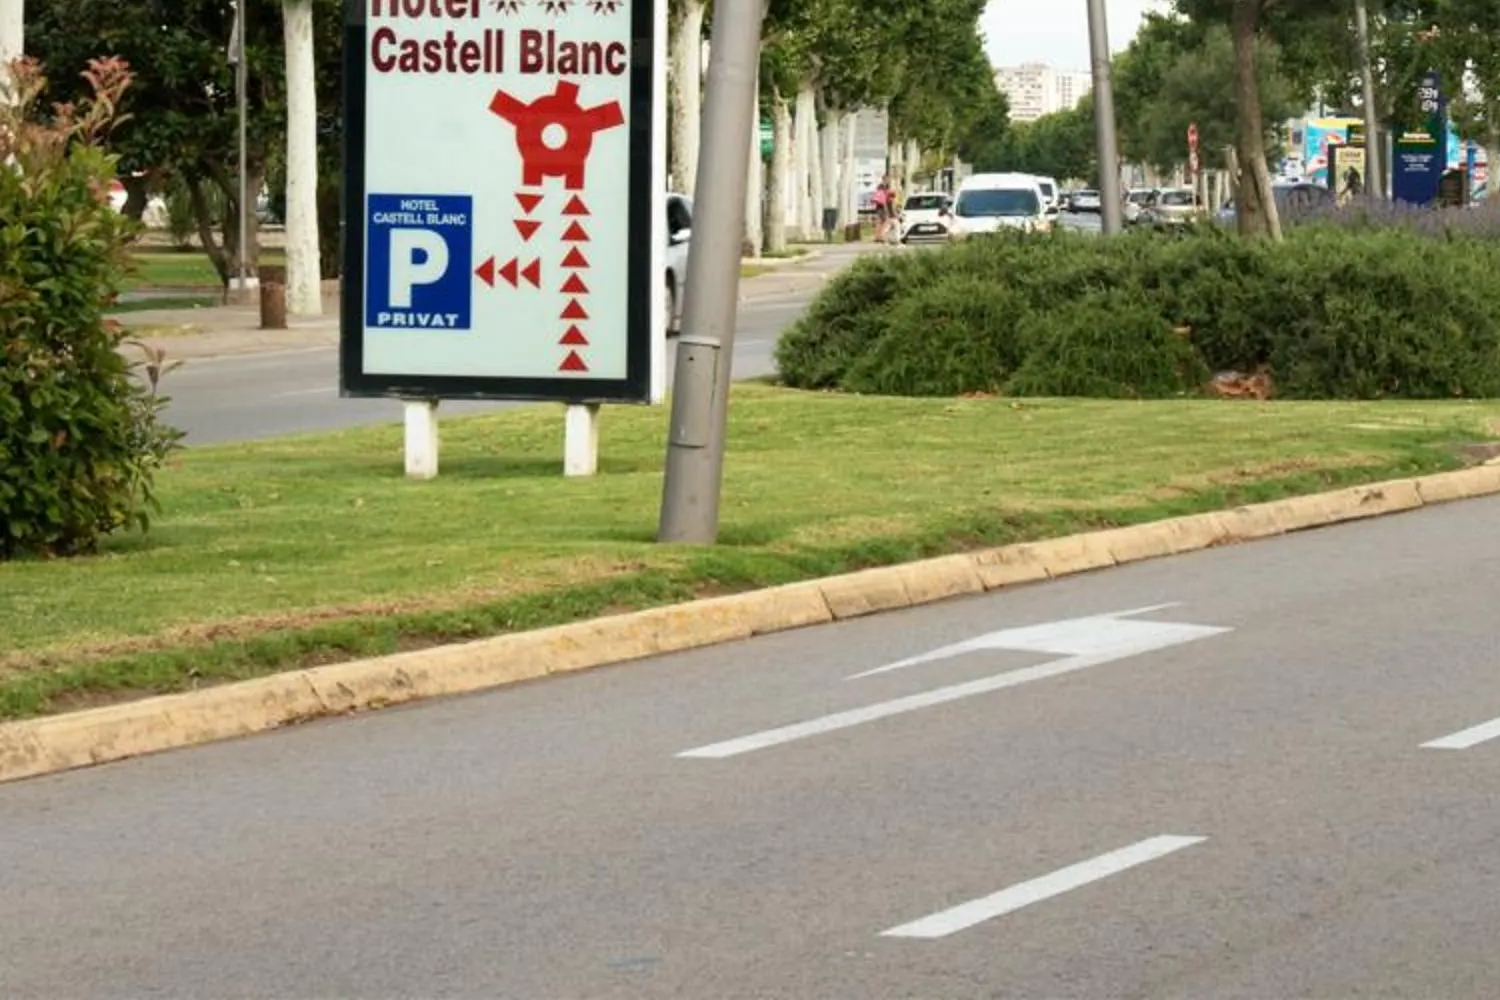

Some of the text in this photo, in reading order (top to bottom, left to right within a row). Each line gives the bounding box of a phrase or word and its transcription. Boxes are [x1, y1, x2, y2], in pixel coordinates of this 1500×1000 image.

[371, 26, 627, 75] Castell Blanc
[401, 199, 439, 211] HOTEL
[373, 212, 467, 226] CASTELL BLANC
[388, 227, 450, 309] P
[377, 311, 459, 327] PRIVAT
